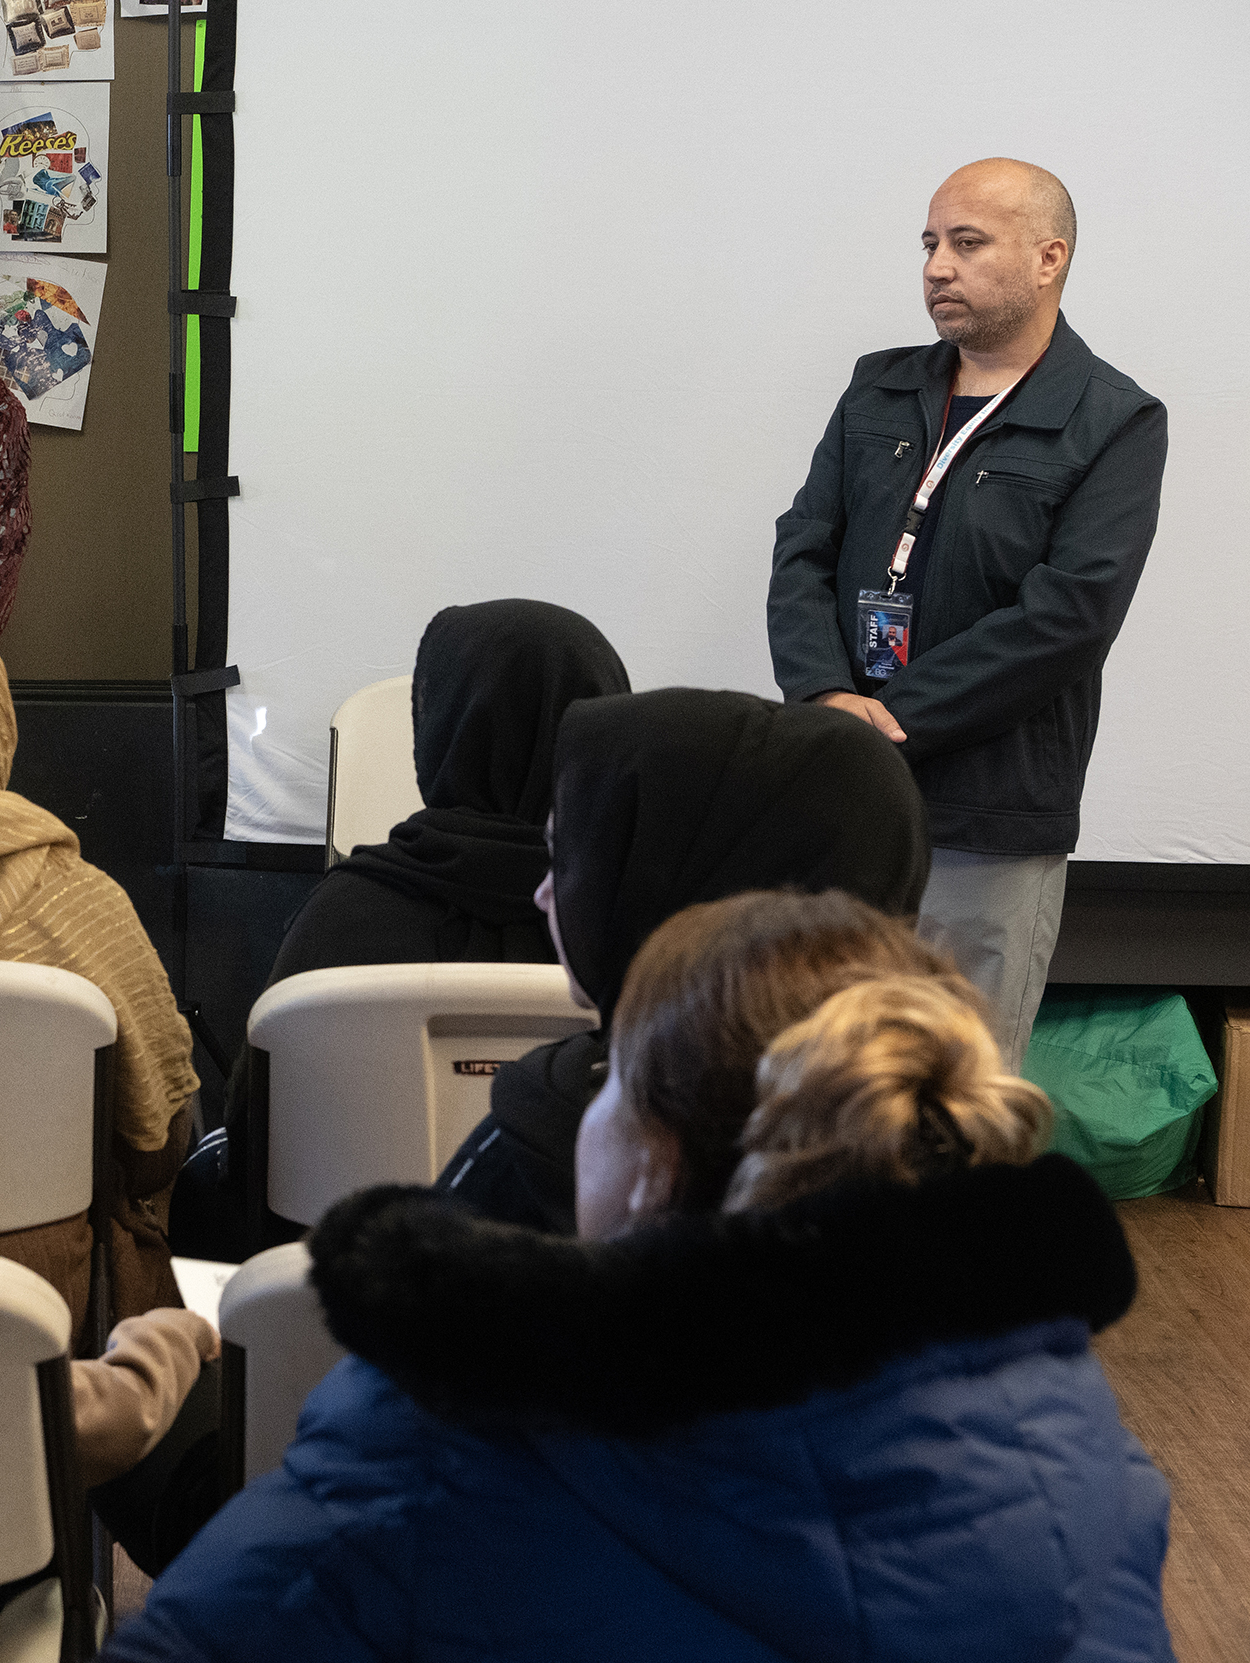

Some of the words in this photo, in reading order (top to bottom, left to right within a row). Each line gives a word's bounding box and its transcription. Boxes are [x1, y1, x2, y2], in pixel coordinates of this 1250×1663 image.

[0, 133, 77, 157] Reese's
[937, 436, 963, 469] Diversity
[961, 414, 983, 436] Equity
[869, 615, 878, 648] STAFF
[460, 1063, 500, 1073] LIFE
